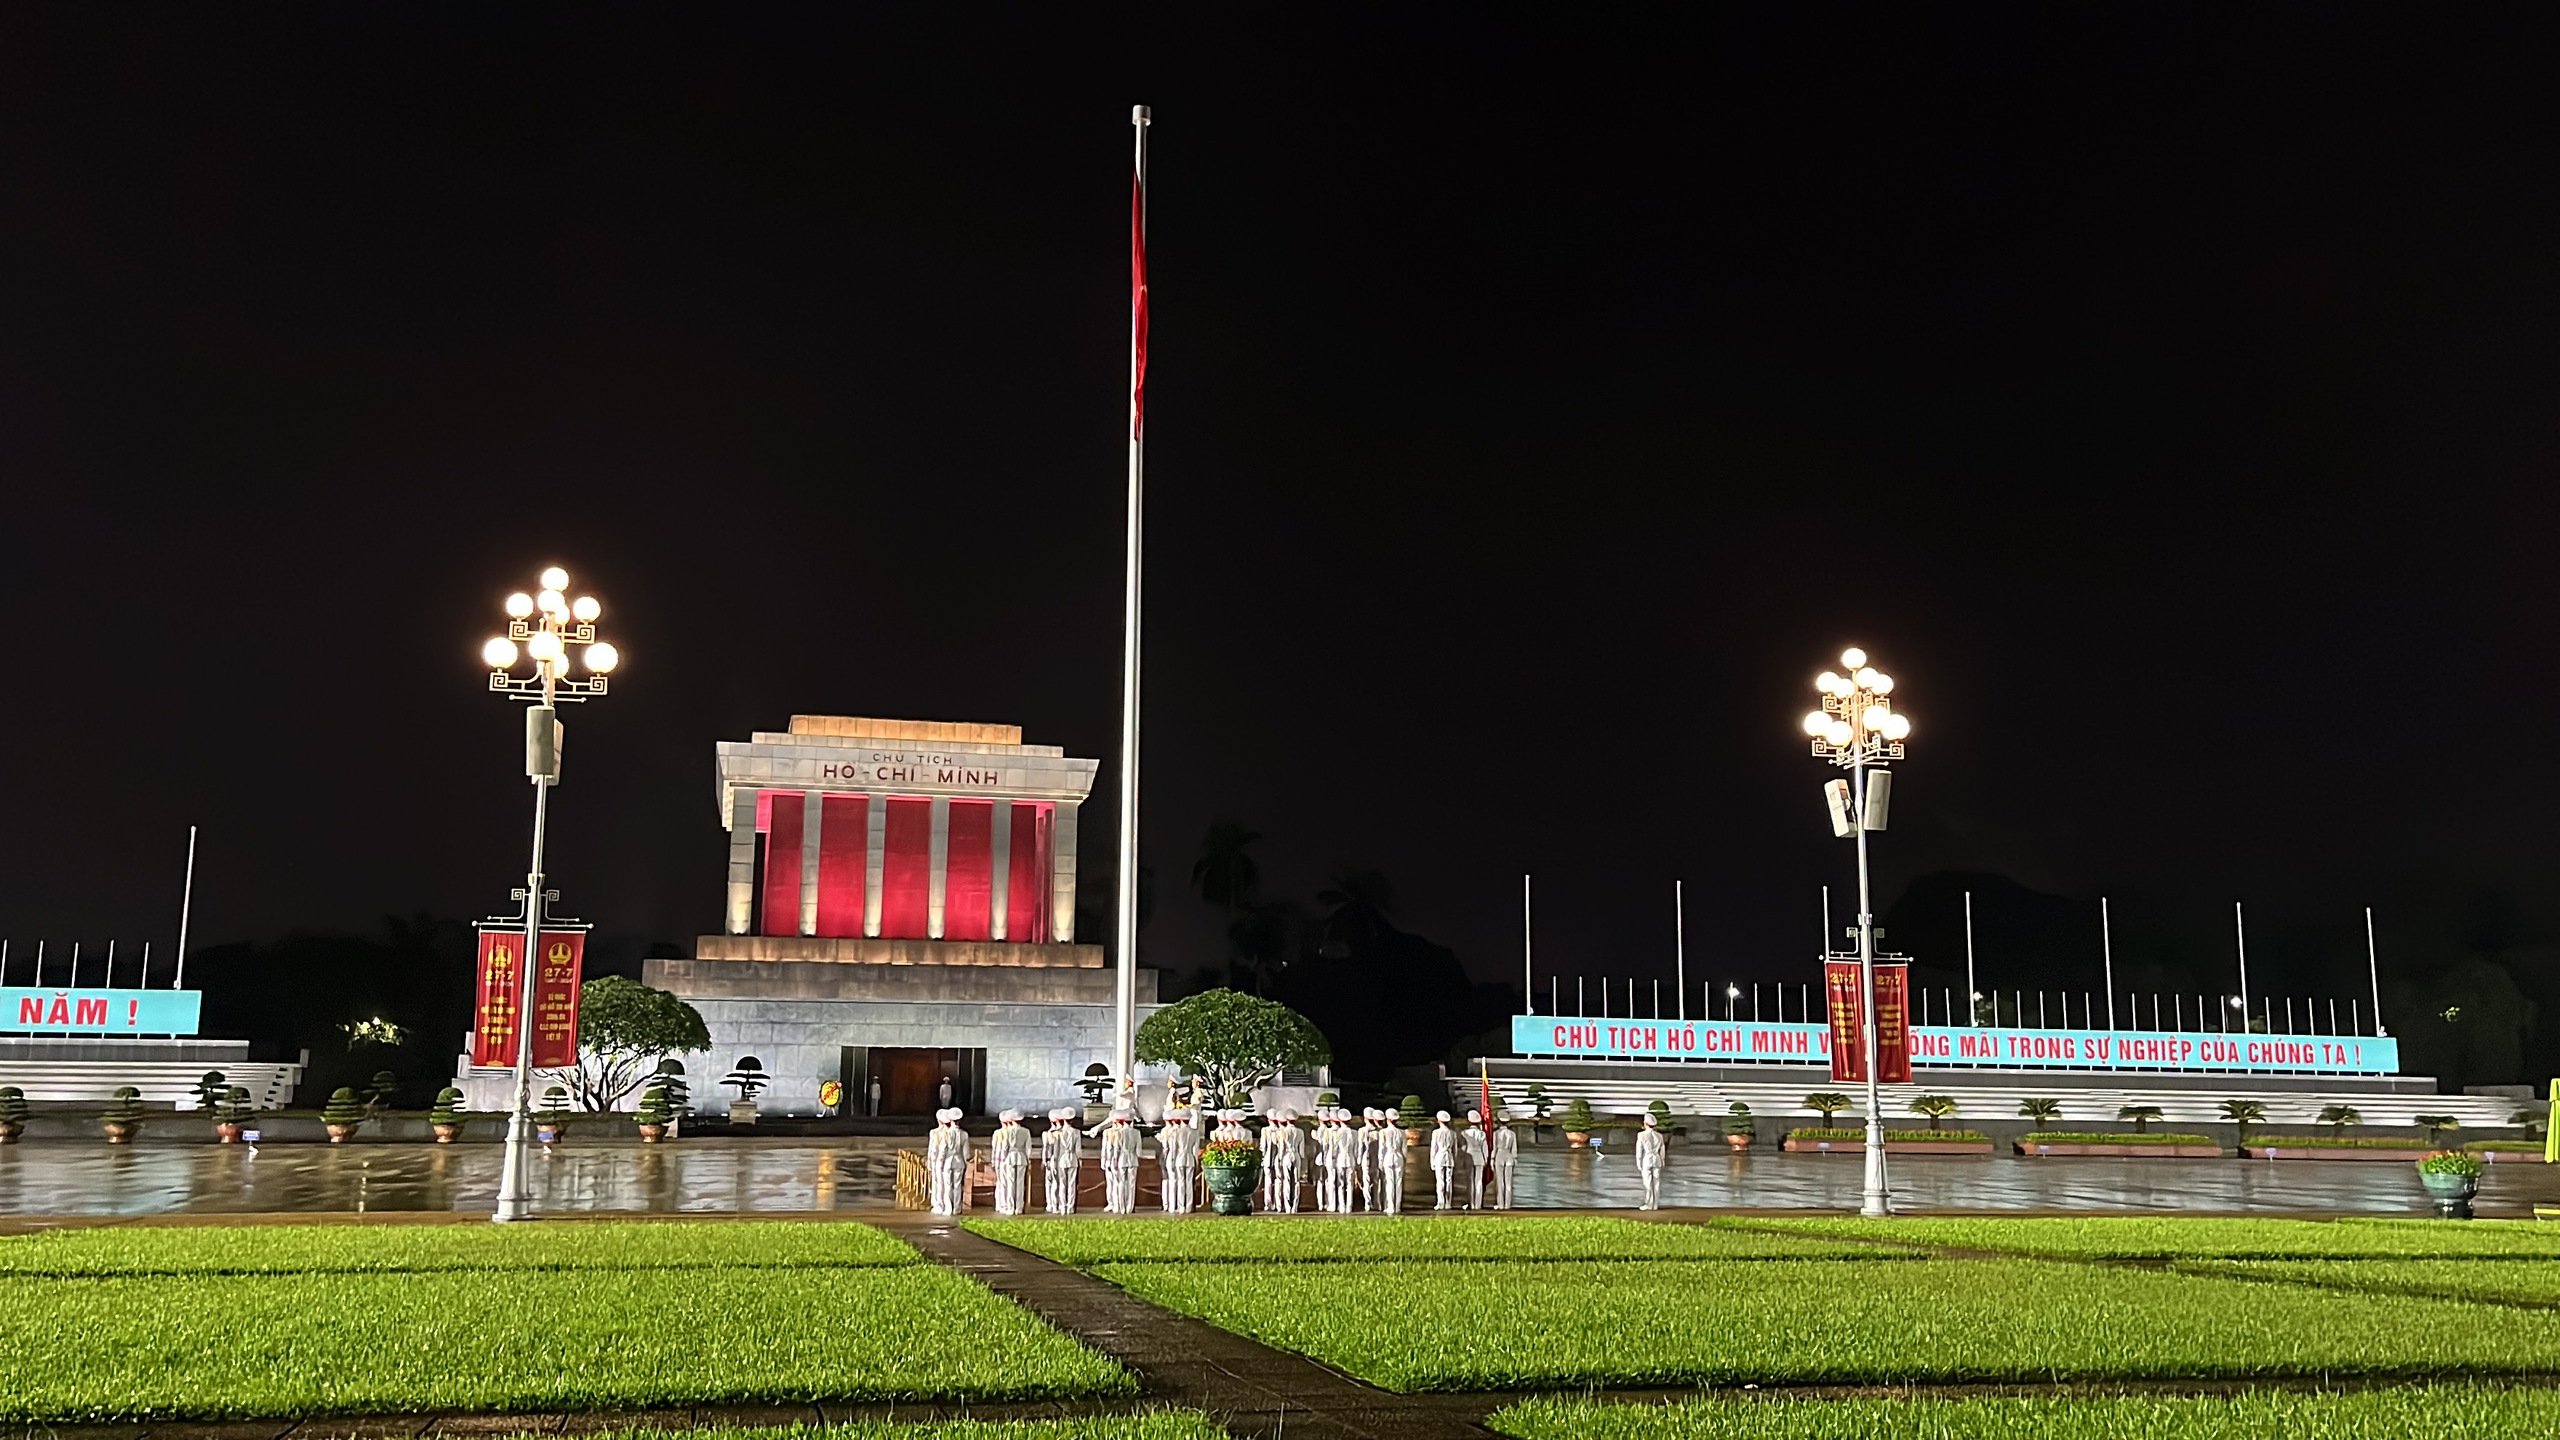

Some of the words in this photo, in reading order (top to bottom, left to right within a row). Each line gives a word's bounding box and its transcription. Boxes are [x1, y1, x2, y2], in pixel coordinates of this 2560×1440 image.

[18, 991, 109, 1025] NĂM
[1553, 1019, 1598, 1048] CHỦ
[1607, 1026, 1657, 1054] TỊCH
[1667, 1021, 1696, 1051] HỒ
[1706, 1025, 1742, 1052] CHÍ
[1752, 1030, 1809, 1054] MINH
[1909, 1028, 1951, 1056] ỐNG
[1959, 1031, 1999, 1058] MÃI
[2007, 1036, 2075, 1059] TRONG
[2084, 1035, 2111, 1064] SỰ
[2118, 1036, 2193, 1065] NGHIỆP
[2200, 1035, 2240, 1063] CỦA
[2247, 1038, 2315, 1064] CHÚNG
[2322, 1043, 2347, 1065] TA
